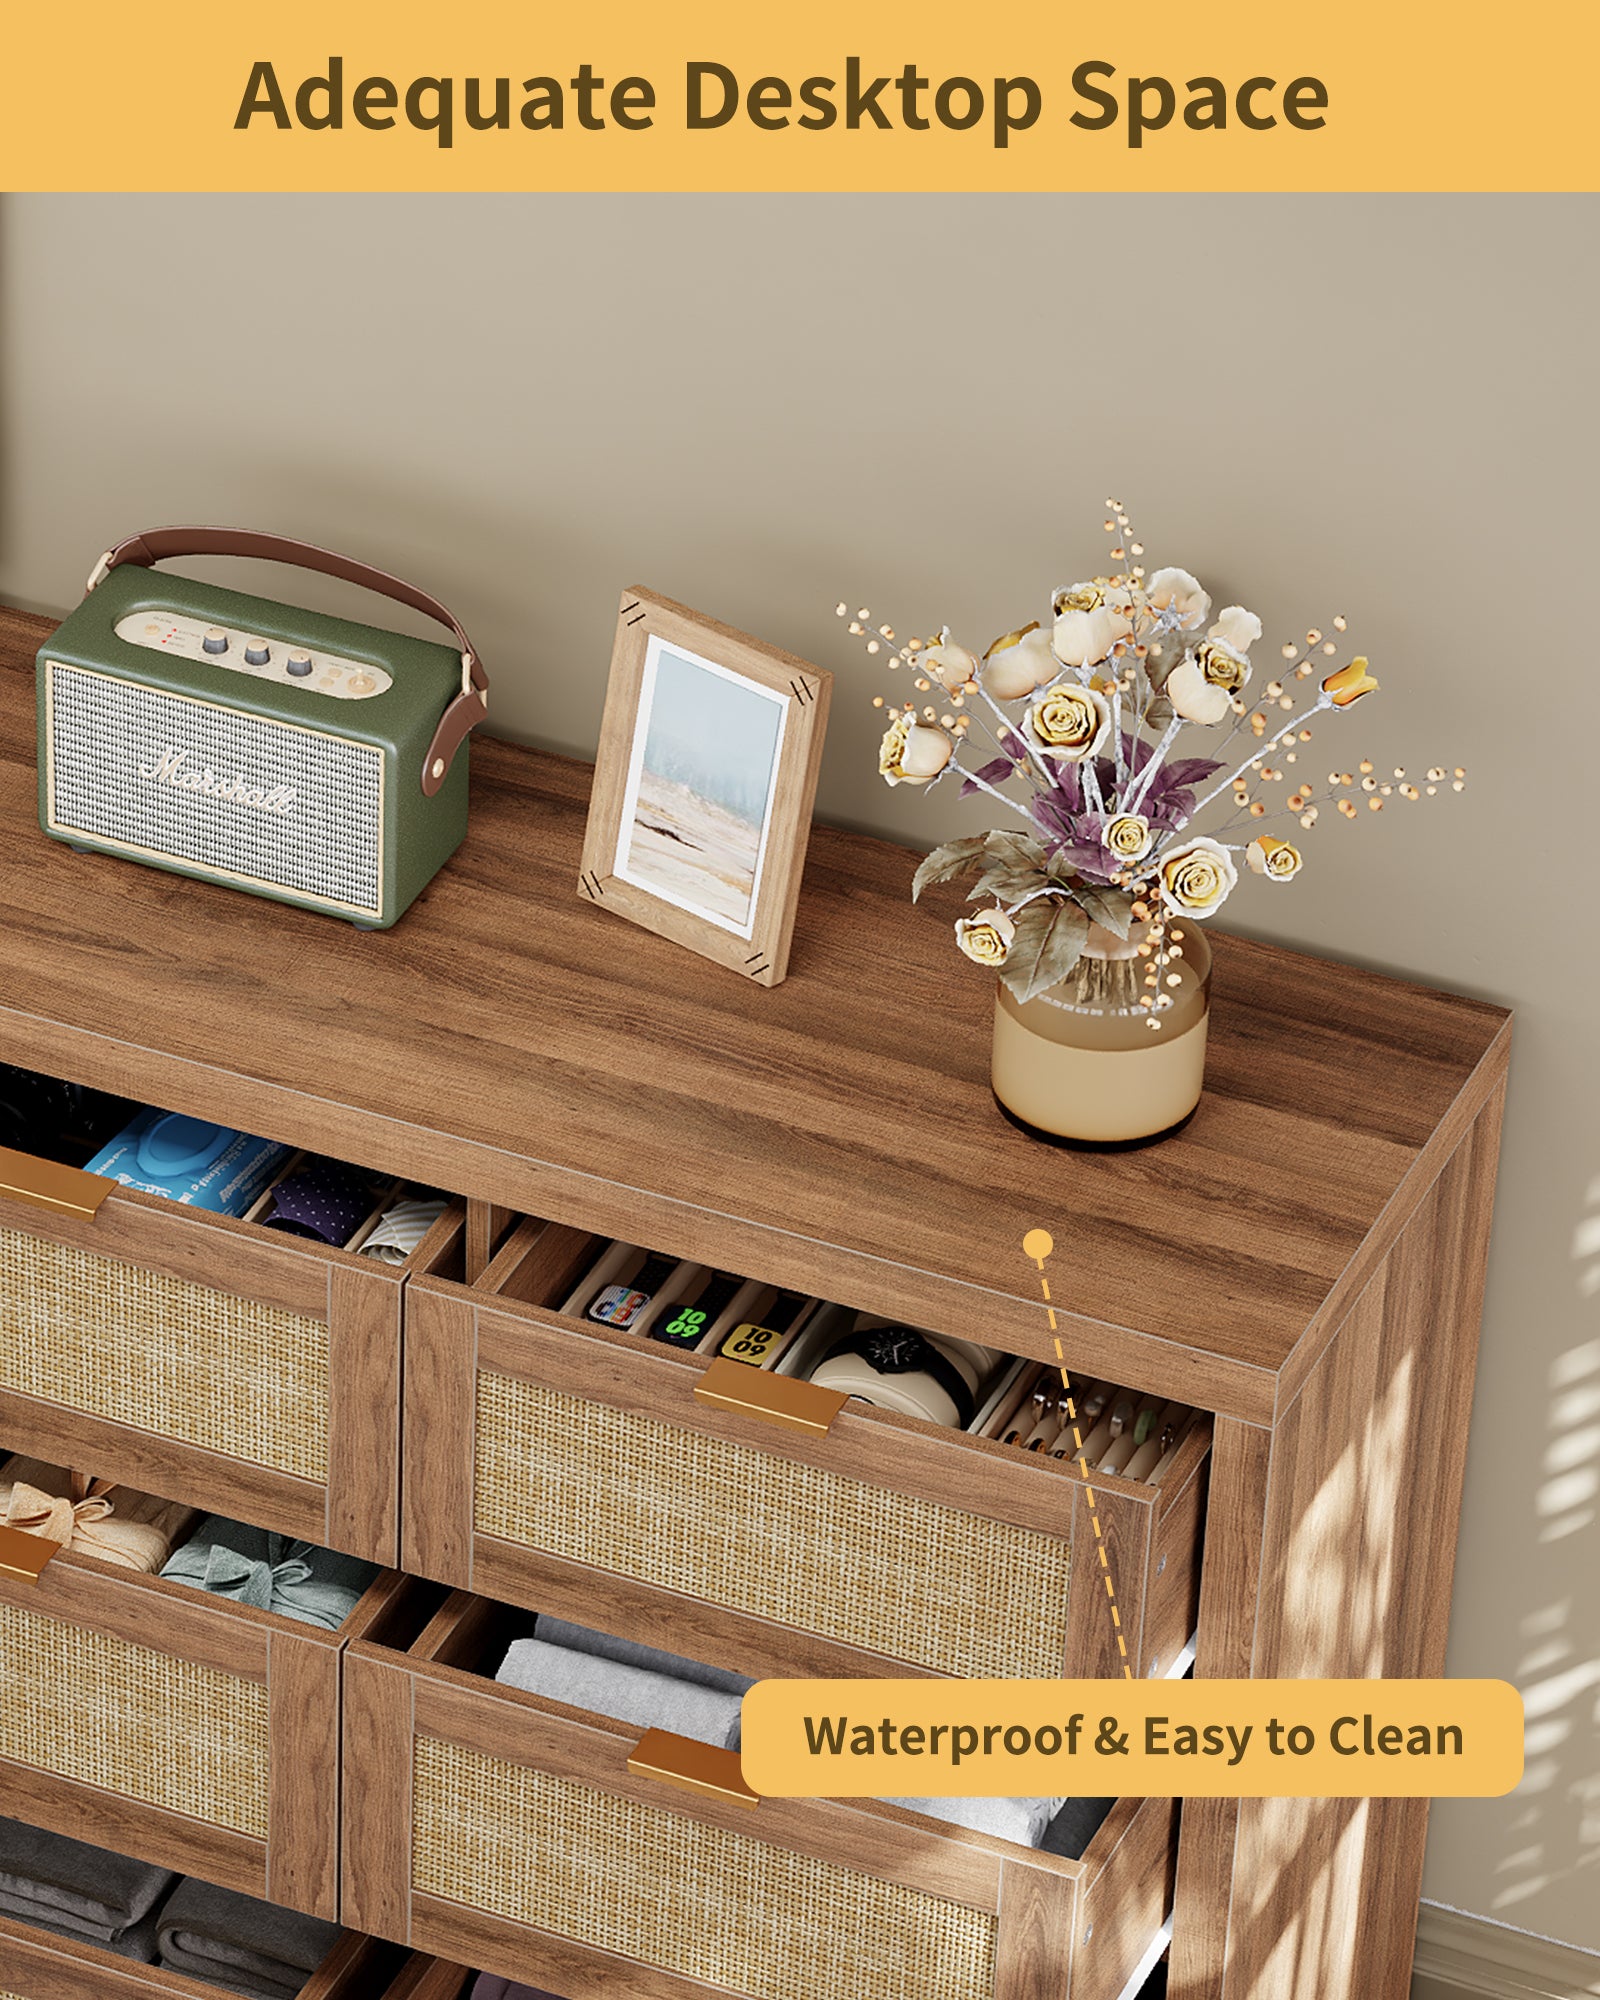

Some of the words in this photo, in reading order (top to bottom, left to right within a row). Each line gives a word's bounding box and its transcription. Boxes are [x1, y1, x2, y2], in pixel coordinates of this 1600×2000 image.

[139, 748, 297, 815] Marshall
[677, 1307, 707, 1325] 10
[665, 1320, 701, 1338] 09
[744, 1327, 773, 1344] 10
[733, 1340, 766, 1357] 09
